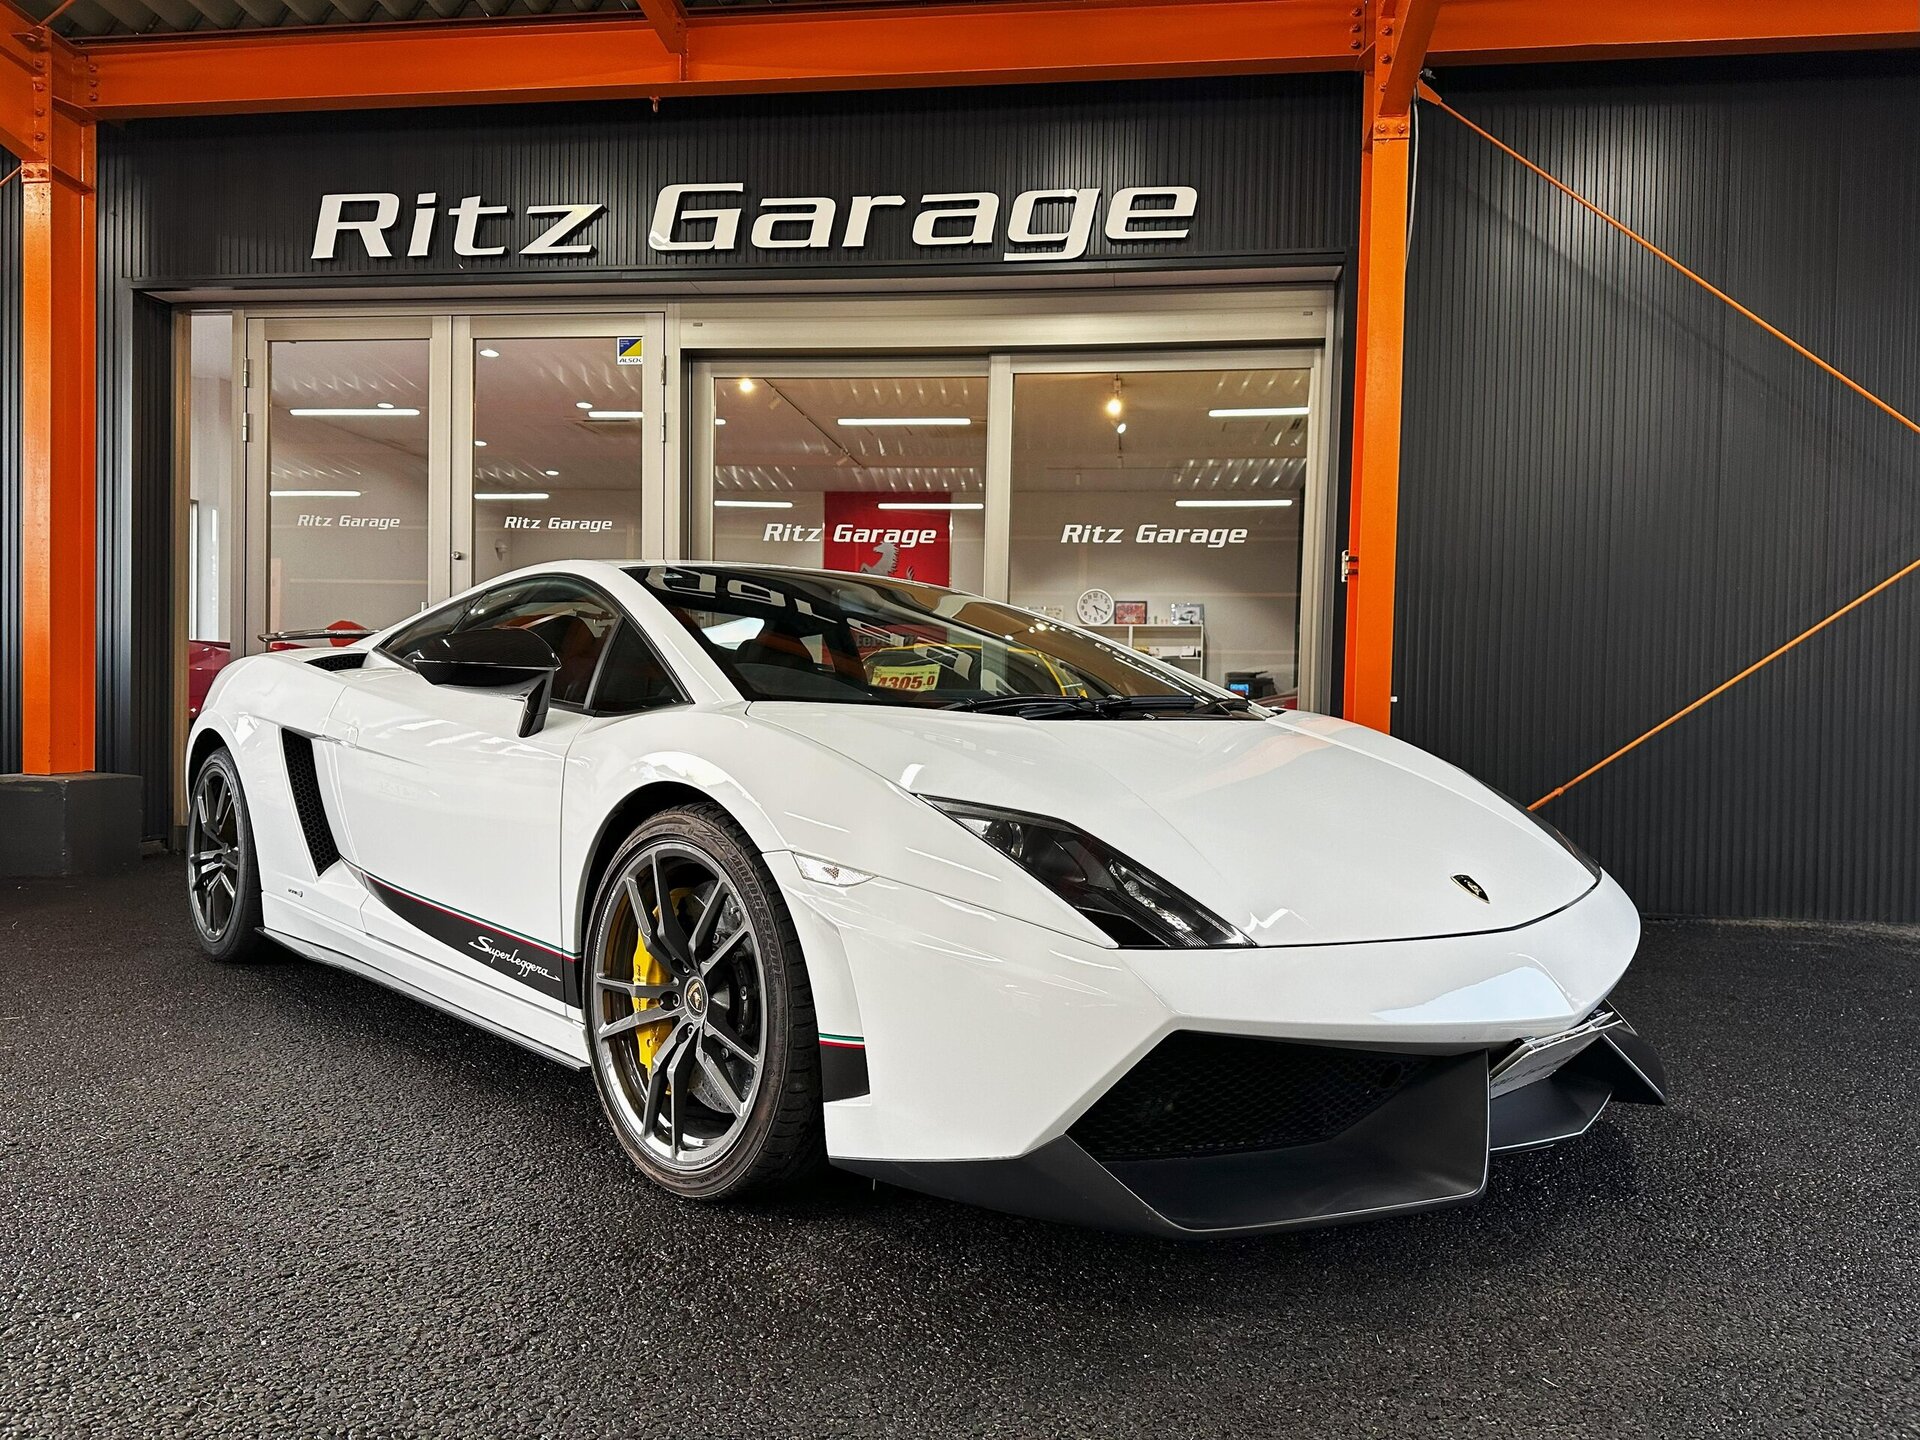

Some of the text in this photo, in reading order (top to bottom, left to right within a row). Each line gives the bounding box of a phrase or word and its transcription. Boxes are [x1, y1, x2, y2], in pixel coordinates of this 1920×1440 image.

[310, 182, 1199, 263] Ritz Garage
[297, 514, 401, 531] Ritz Garage
[504, 516, 613, 533] Ritz Garage
[763, 522, 937, 549] Ritz Garage
[1060, 524, 1248, 549] Ritz Garage
[467, 935, 562, 982] Superleggera
